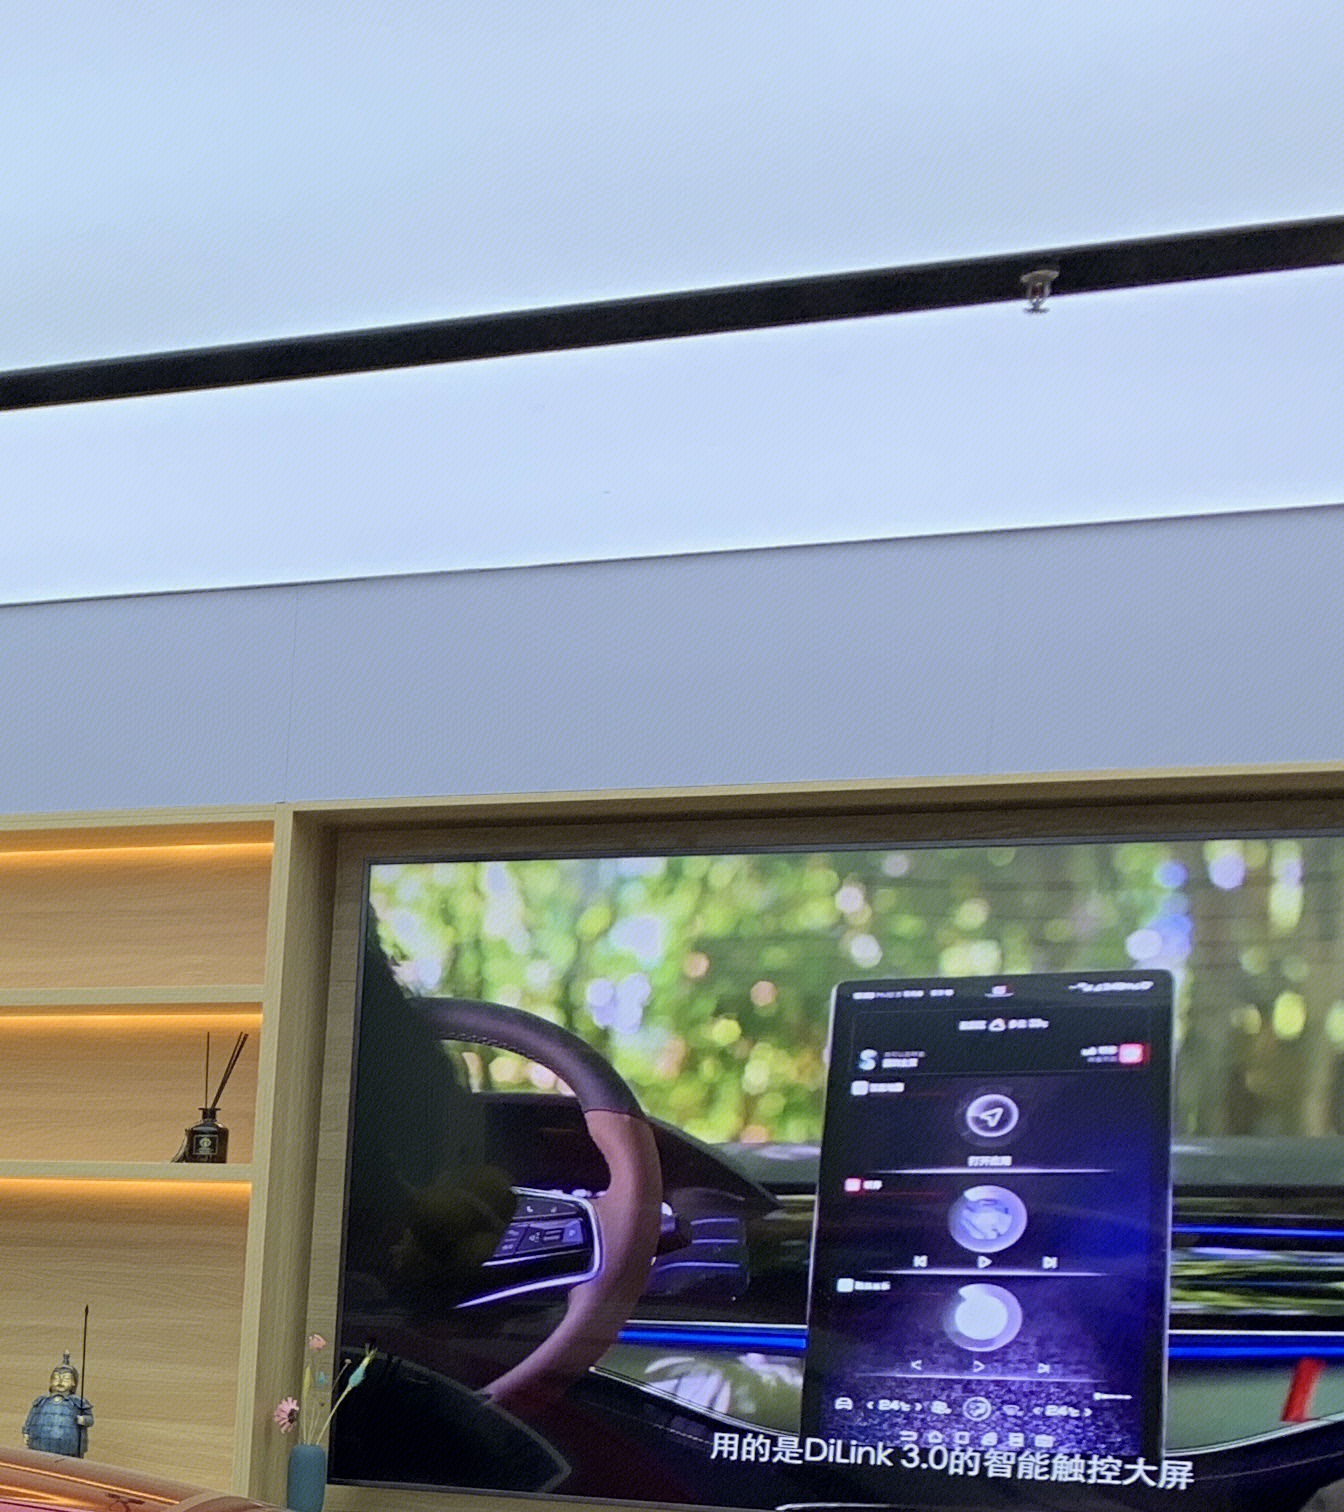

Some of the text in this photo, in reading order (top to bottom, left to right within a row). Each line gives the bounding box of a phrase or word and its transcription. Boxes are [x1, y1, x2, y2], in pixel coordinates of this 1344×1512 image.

[709, 1430, 1195, 1491] 用的是DiLink 3.0的智能触控大屏
